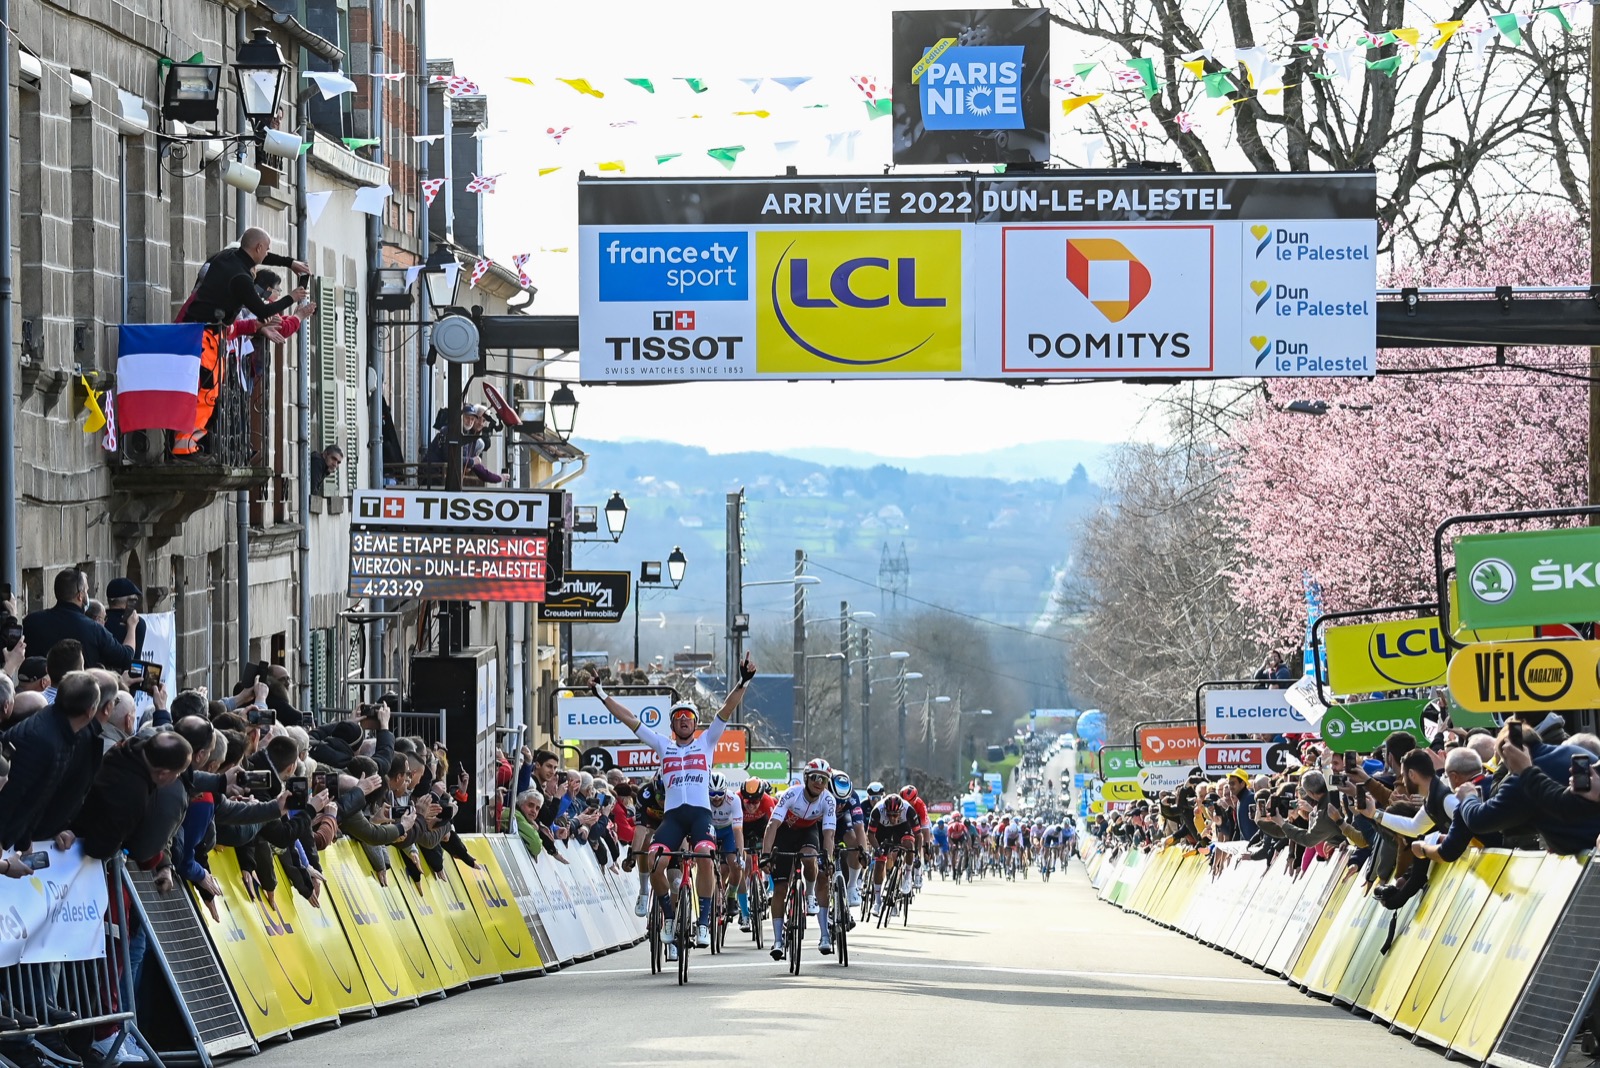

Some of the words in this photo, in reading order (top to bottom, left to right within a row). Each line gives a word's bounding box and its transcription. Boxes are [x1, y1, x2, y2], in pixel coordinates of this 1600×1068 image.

[927, 61, 1018, 85] PARIS
[927, 85, 1017, 117] NICE
[761, 187, 891, 214] ARRIVÉE
[900, 192, 972, 214] 2022
[982, 187, 1232, 212] DUN-LE-PALESTEL
[1276, 229, 1309, 244] Dun
[1276, 245, 1292, 261] le
[1297, 245, 1369, 261] Palestel
[666, 265, 737, 293] sport
[790, 257, 947, 309] LCL
[1275, 284, 1309, 299] Dun
[1275, 301, 1291, 316] le
[1296, 301, 1369, 316] Palestel
[605, 336, 744, 362] TISSOT
[1028, 333, 1191, 359] DOMITYS
[1275, 340, 1308, 355] Dun
[605, 367, 636, 375] SWISS
[640, 367, 685, 375] WATCHES
[690, 367, 719, 375] SINCE
[723, 366, 744, 374] 1853
[1275, 356, 1291, 372] le
[1296, 356, 1368, 372] Palestel
[415, 497, 542, 522] TISSOT
[403, 536, 451, 554] ETAPE
[456, 539, 545, 557] PARIS-NICE
[352, 557, 412, 575] VIERZON
[425, 559, 545, 578] DUN-LE-PALESTEL
[1530, 558, 1600, 592] ŠK
[362, 579, 424, 597] 4:23:29
[547, 579, 602, 597] entury
[596, 588, 613, 608] 21
[544, 609, 582, 618] Creusberri
[1376, 628, 1446, 660] LCL
[1527, 667, 1563, 684] MAGAZINE
[1215, 705, 1288, 719] E.Leclerc
[1350, 717, 1417, 733] ŠKODA
[590, 754, 604, 770] 25
[1217, 749, 1252, 763] RMC
[1150, 772, 1163, 780] Dun
[1113, 784, 1137, 793] LCL
